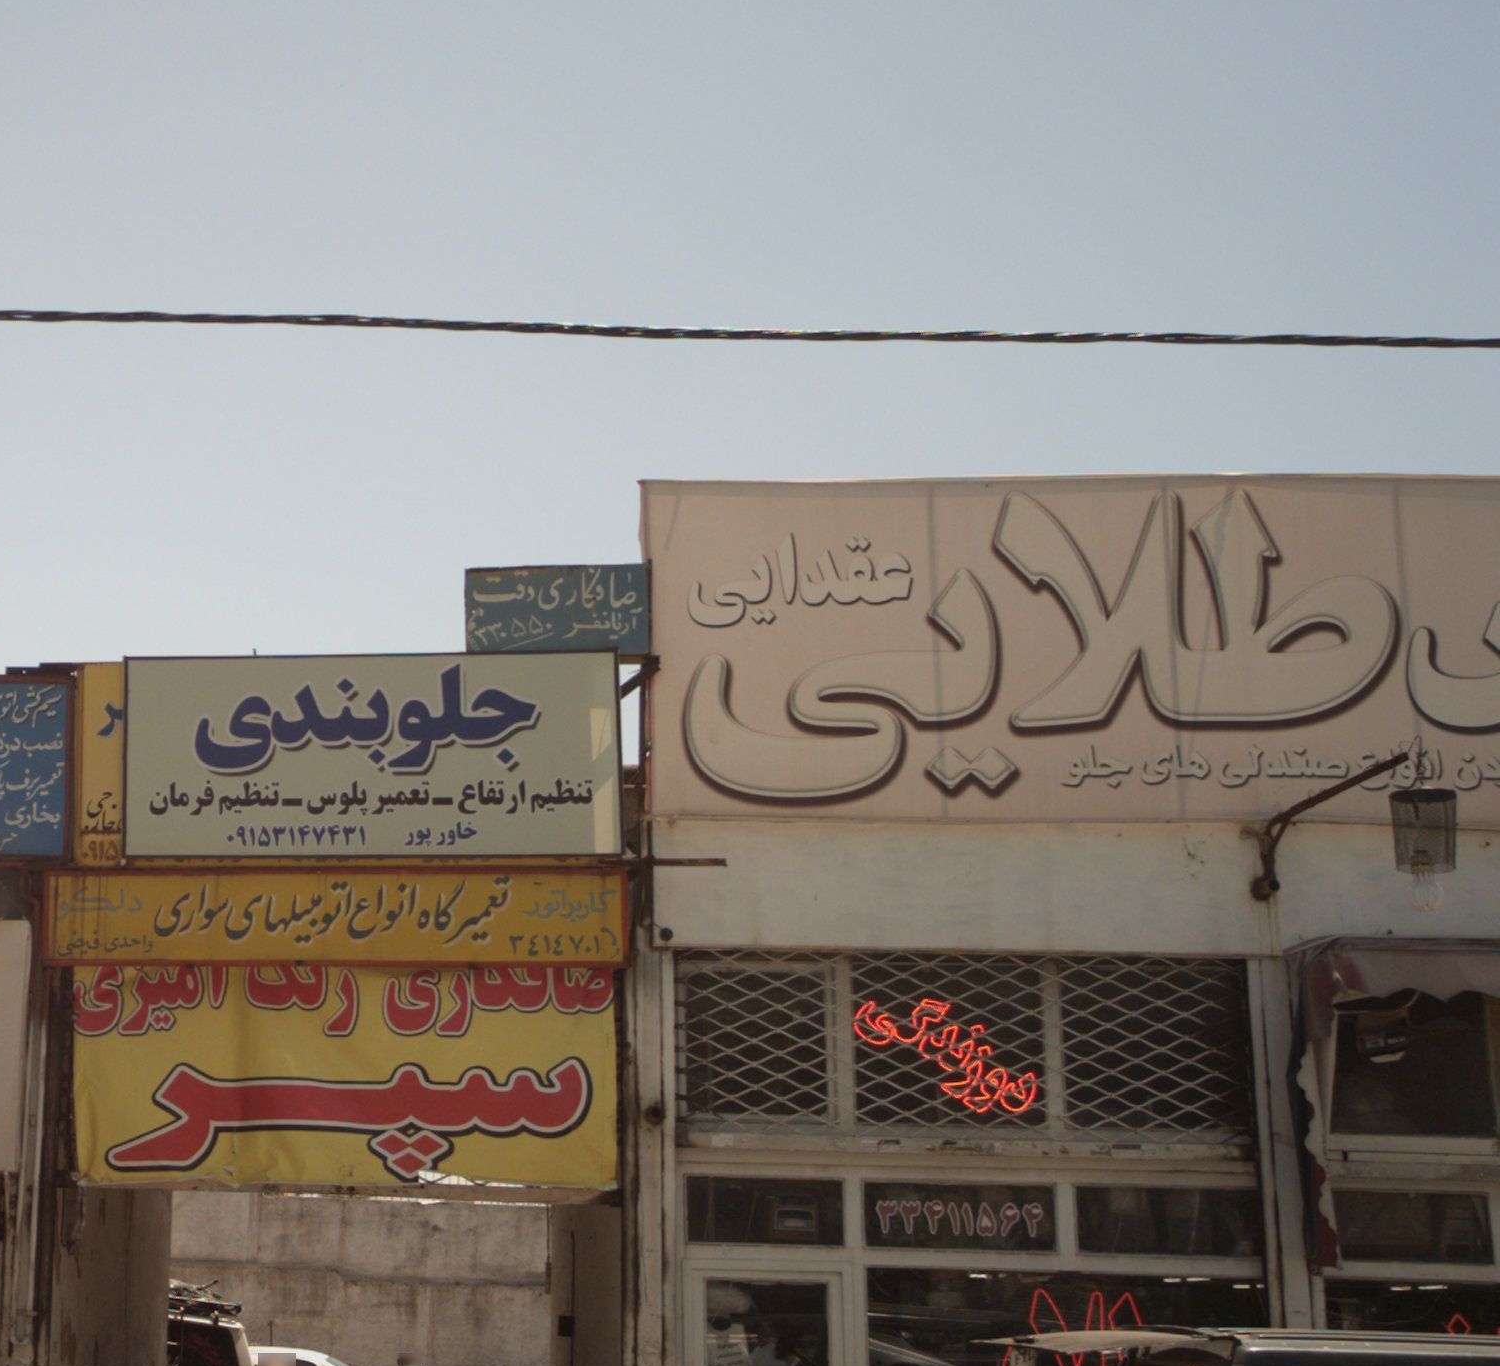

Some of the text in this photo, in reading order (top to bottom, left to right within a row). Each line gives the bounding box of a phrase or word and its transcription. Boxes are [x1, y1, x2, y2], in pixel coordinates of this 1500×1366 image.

[681, 488, 1402, 804] طلایی
[194, 661, 542, 775] جلوبندی
[22, 732, 64, 758] نصب
[1061, 743, 1134, 791] جلو
[1141, 744, 1211, 785] های
[1218, 743, 1351, 788] صندلی
[4, 802, 61, 829] بخاری
[148, 782, 215, 816] فرمان
[217, 782, 280, 816] تنظیم
[306, 784, 368, 818] پلوس
[375, 780, 430, 816] تعمیر
[457, 780, 526, 816] ارتفاع
[530, 780, 594, 816] تنظیم
[226, 824, 366, 847] ۰۹۱۵۳۱۴۷۴۳۱
[153, 884, 229, 938] سواری
[347, 883, 420, 940] انواع
[107, 1057, 592, 1180] سپر
[875, 1199, 1044, 1238] ۳۳۴۱۱۵۶۴
